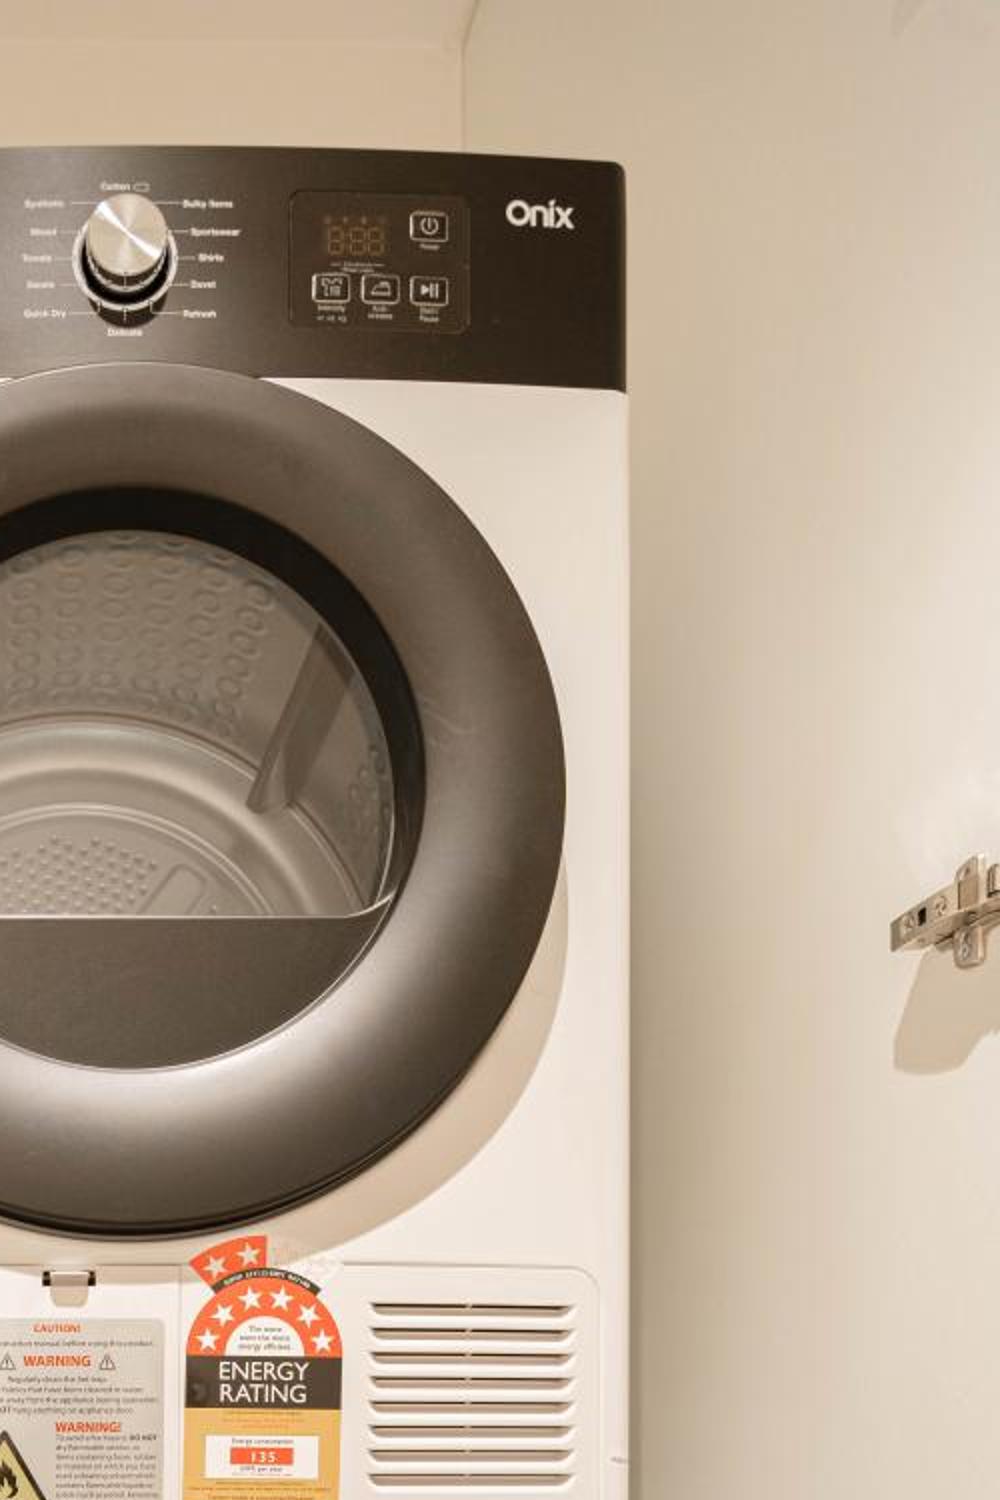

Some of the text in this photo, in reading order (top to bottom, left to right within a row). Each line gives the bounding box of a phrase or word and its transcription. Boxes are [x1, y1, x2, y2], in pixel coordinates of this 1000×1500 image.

[505, 199, 575, 230] Onix
[23, 1355, 92, 1368] WARNING
[219, 1361, 310, 1381] ENERGY
[219, 1383, 308, 1404] RATING
[55, 1421, 122, 1433] WARNING!
